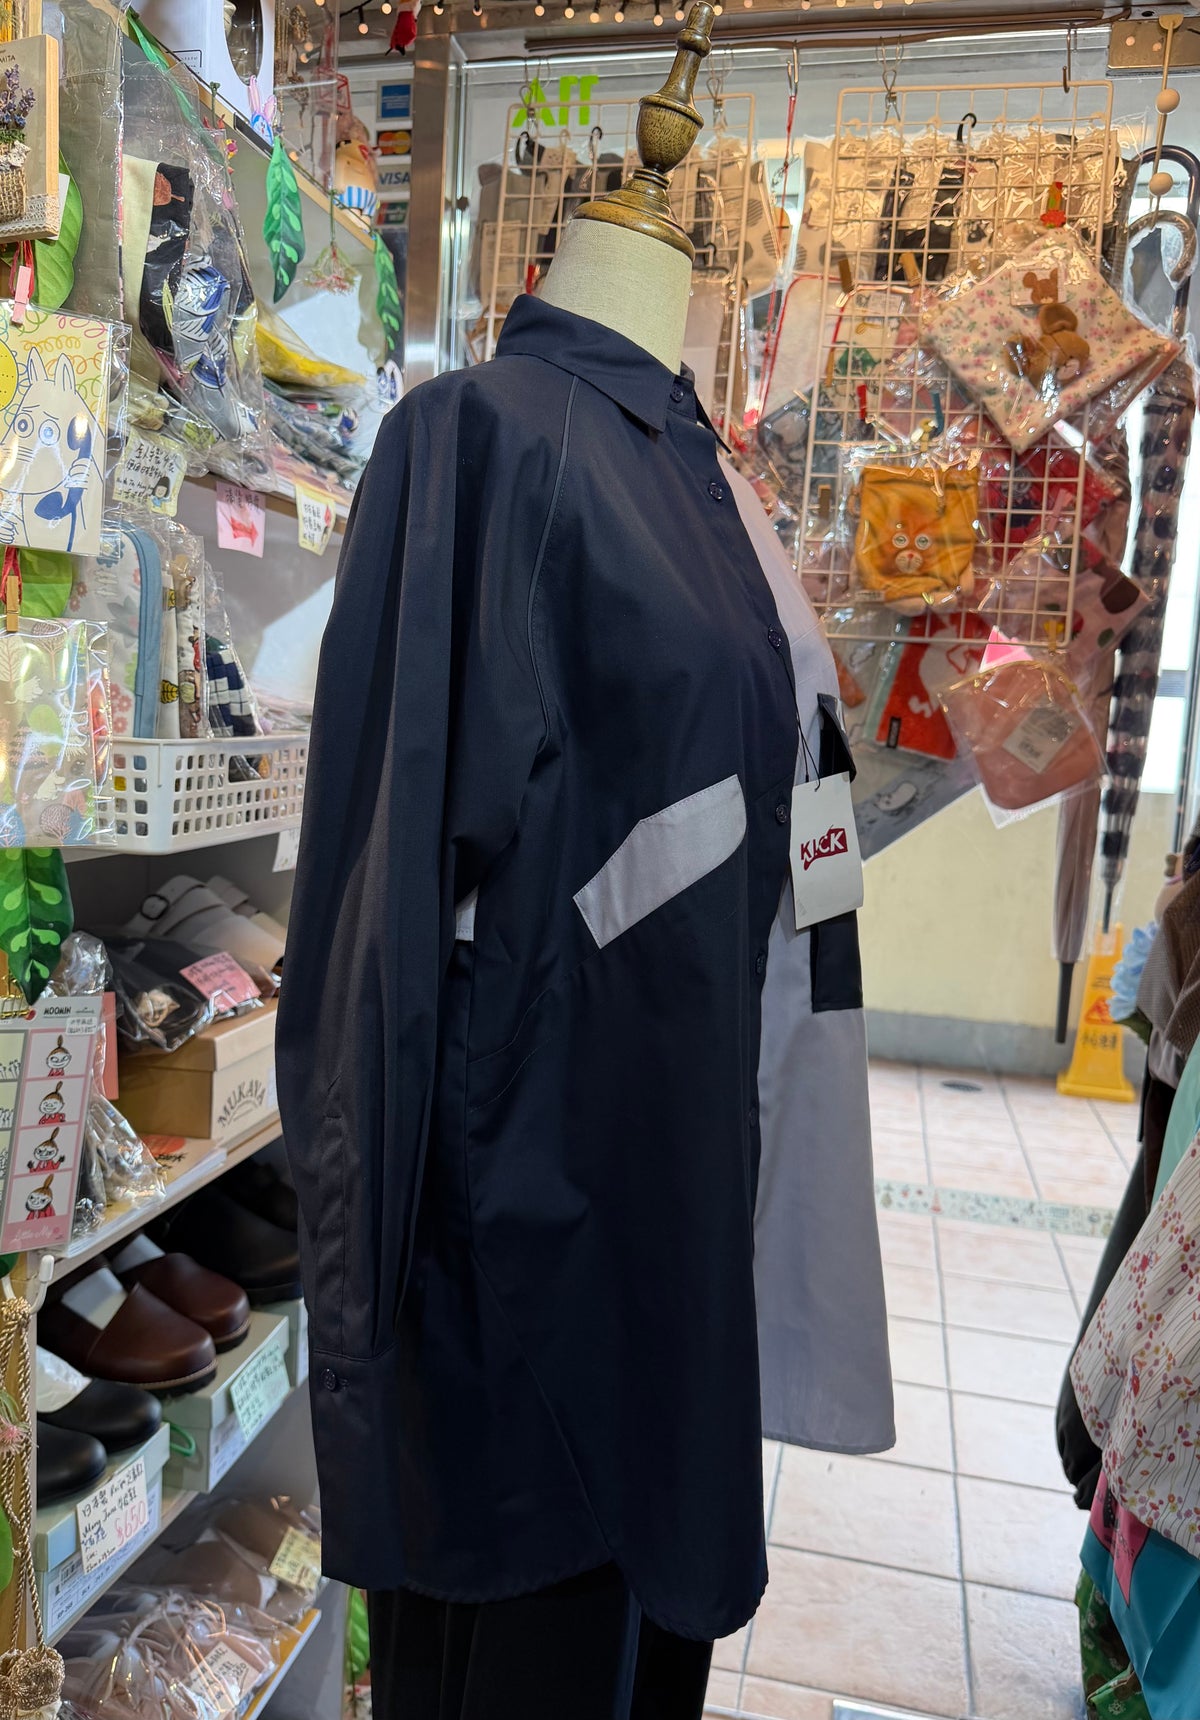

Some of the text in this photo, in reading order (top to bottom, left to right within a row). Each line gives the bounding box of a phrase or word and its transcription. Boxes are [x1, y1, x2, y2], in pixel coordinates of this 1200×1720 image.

[379, 172, 411, 185] VISA
[801, 828, 845, 861] KICK
[43, 1006, 72, 1015] MOOMIN
[115, 1501, 147, 1547] $650
